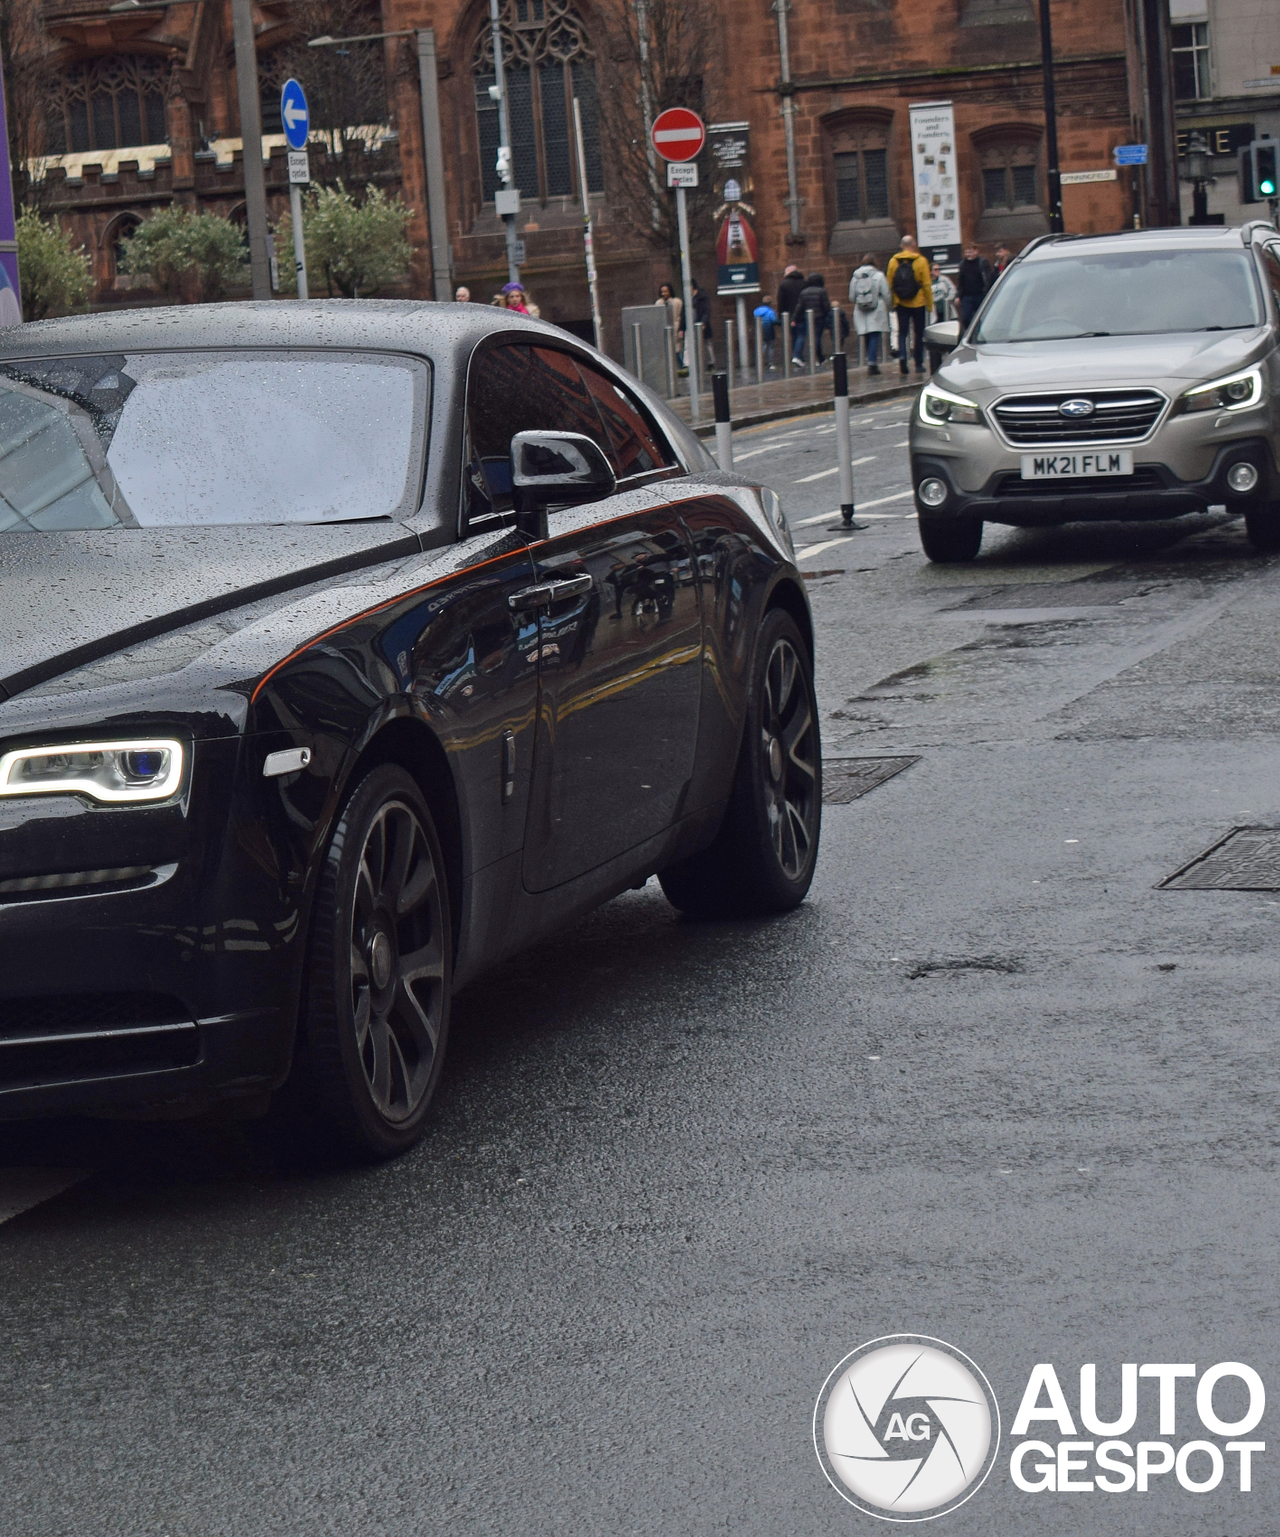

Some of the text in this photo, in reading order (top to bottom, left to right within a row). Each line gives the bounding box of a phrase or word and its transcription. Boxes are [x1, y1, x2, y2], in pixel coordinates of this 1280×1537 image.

[914, 115, 950, 124] Founders
[925, 123, 939, 131] and
[290, 156, 306, 167] Except
[292, 168, 307, 180] cycles
[670, 166, 694, 175] Except
[1034, 454, 1120, 475] MK21 FLM
